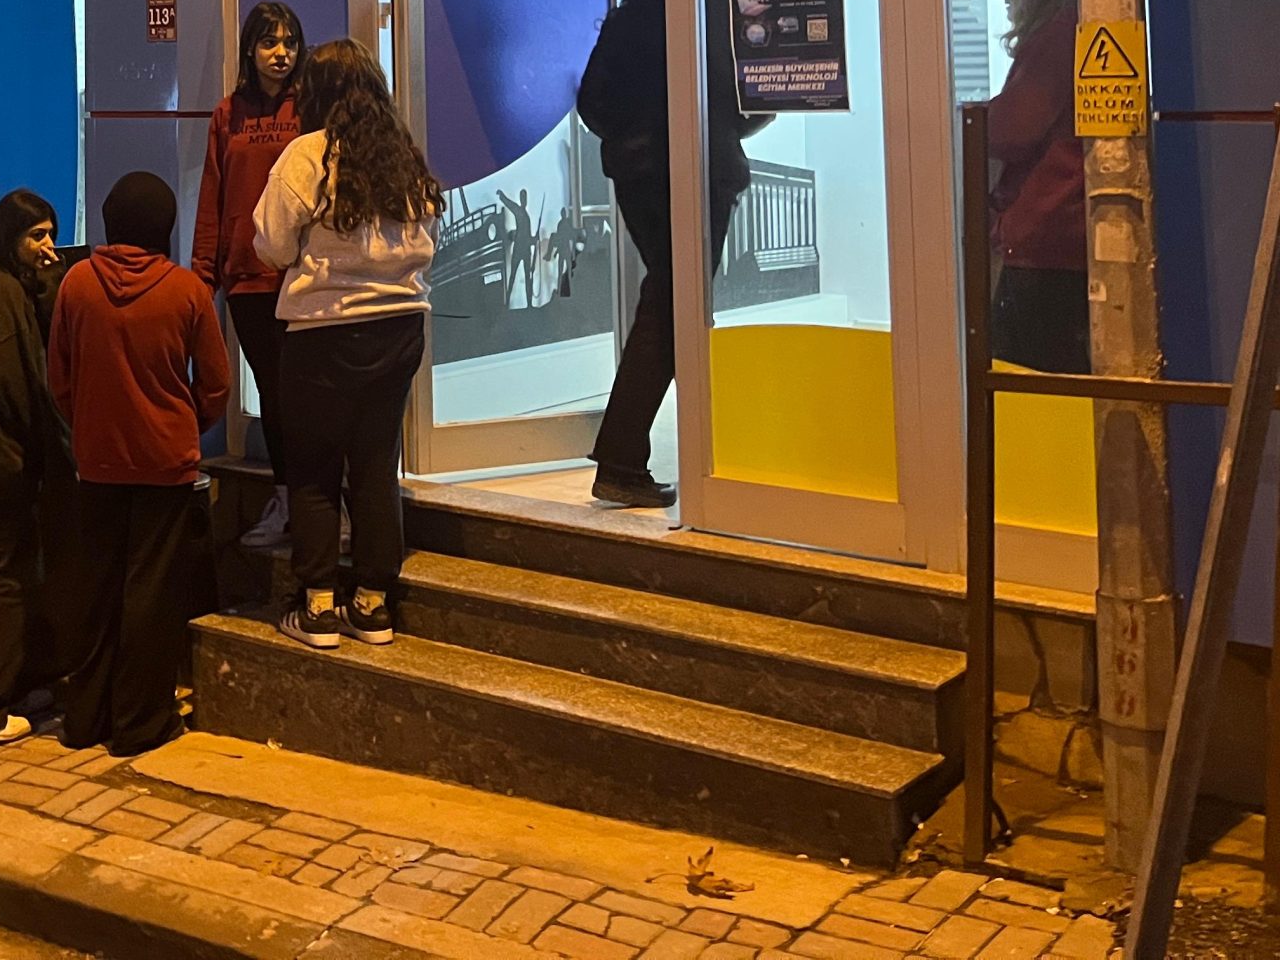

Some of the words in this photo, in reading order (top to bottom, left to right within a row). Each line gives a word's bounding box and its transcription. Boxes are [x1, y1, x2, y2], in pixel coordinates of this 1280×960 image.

[744, 64, 784, 73] BALIKESİR
[785, 61, 838, 73] BÜYÜKŞEHİR
[746, 73, 789, 83] BELEDİYESİ
[791, 71, 838, 82] TEKNOLOJİ
[758, 82, 786, 92] EĞİTİM
[788, 81, 825, 91] MERKEZİ
[266, 122, 299, 133] SULTA
